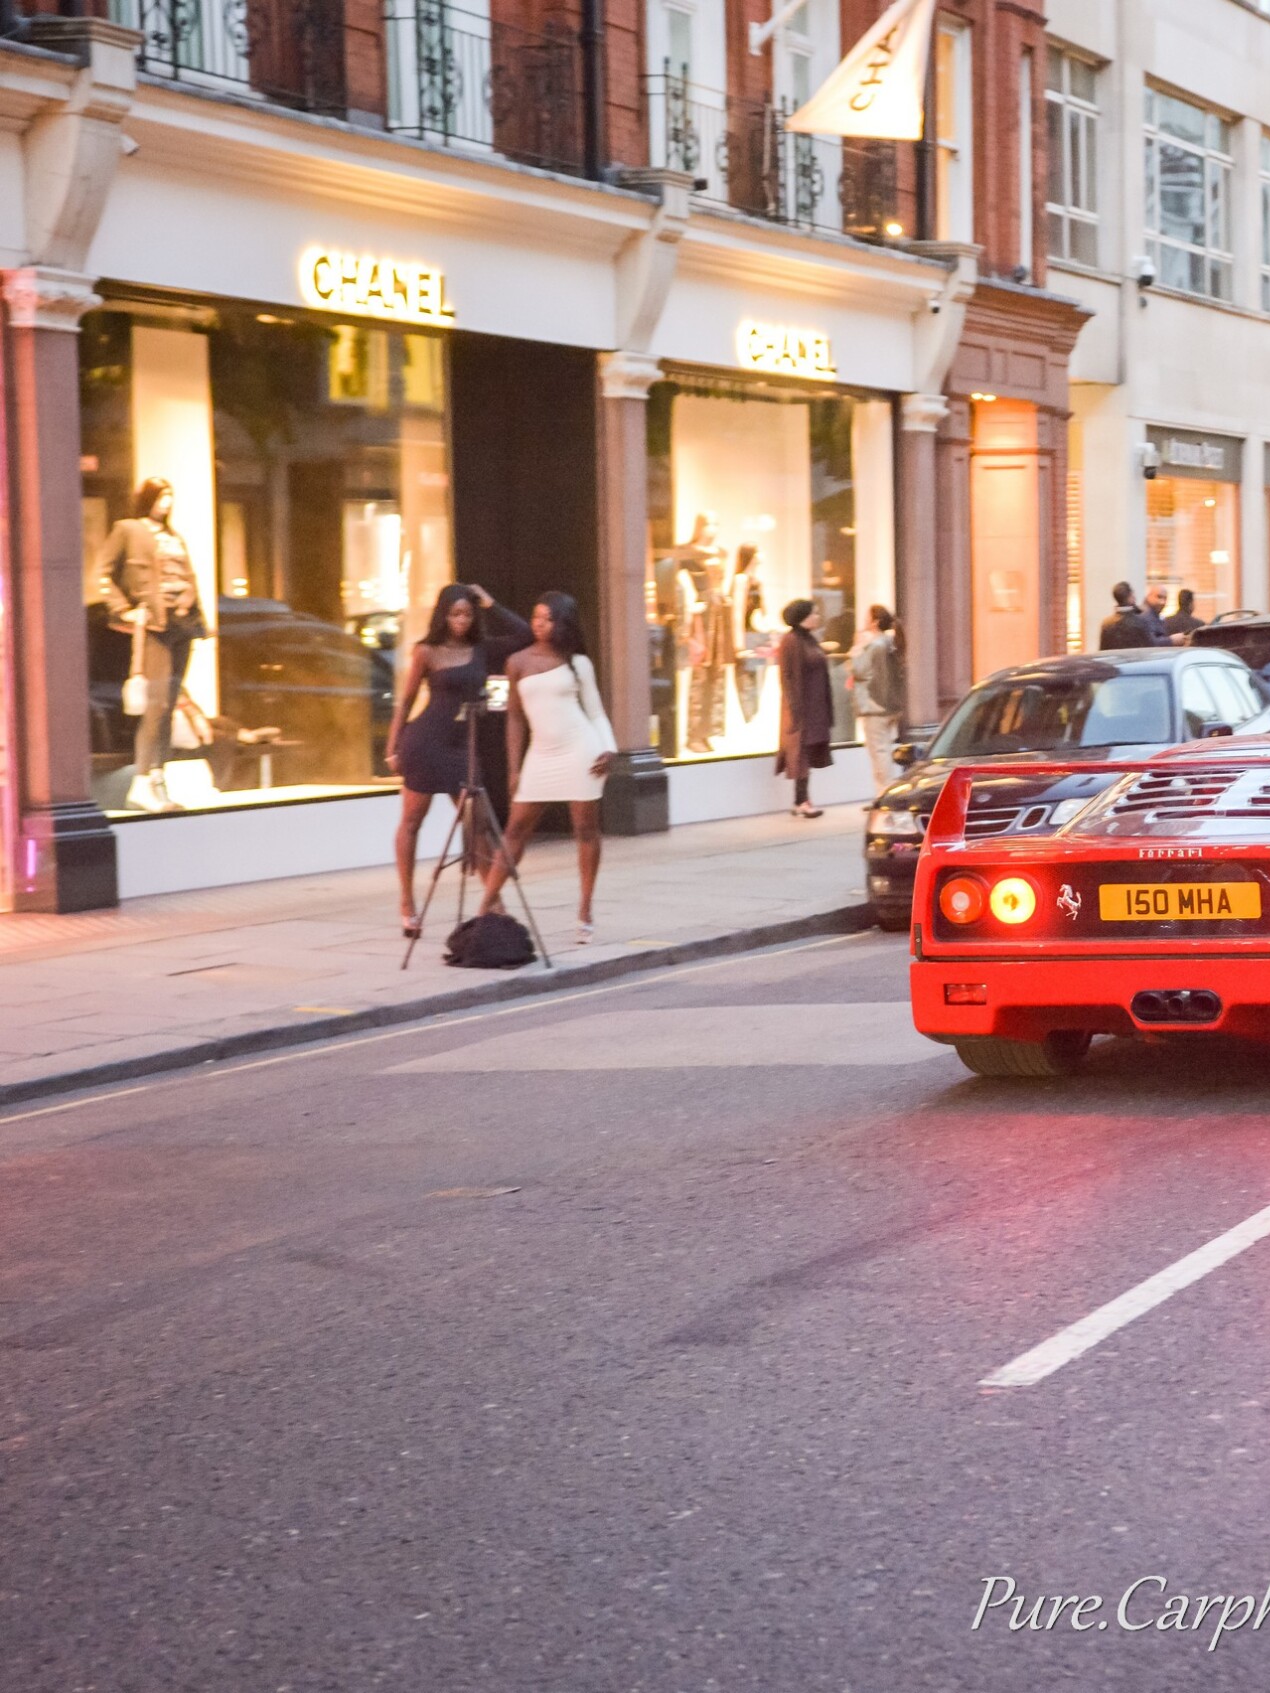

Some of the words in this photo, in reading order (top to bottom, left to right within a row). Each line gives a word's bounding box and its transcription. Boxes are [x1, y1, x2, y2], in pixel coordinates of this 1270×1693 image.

[311, 254, 456, 318] CHANEL
[1139, 848, 1202, 858] Ferrari
[1126, 889, 1169, 915] 150
[1178, 888, 1232, 914] MHA
